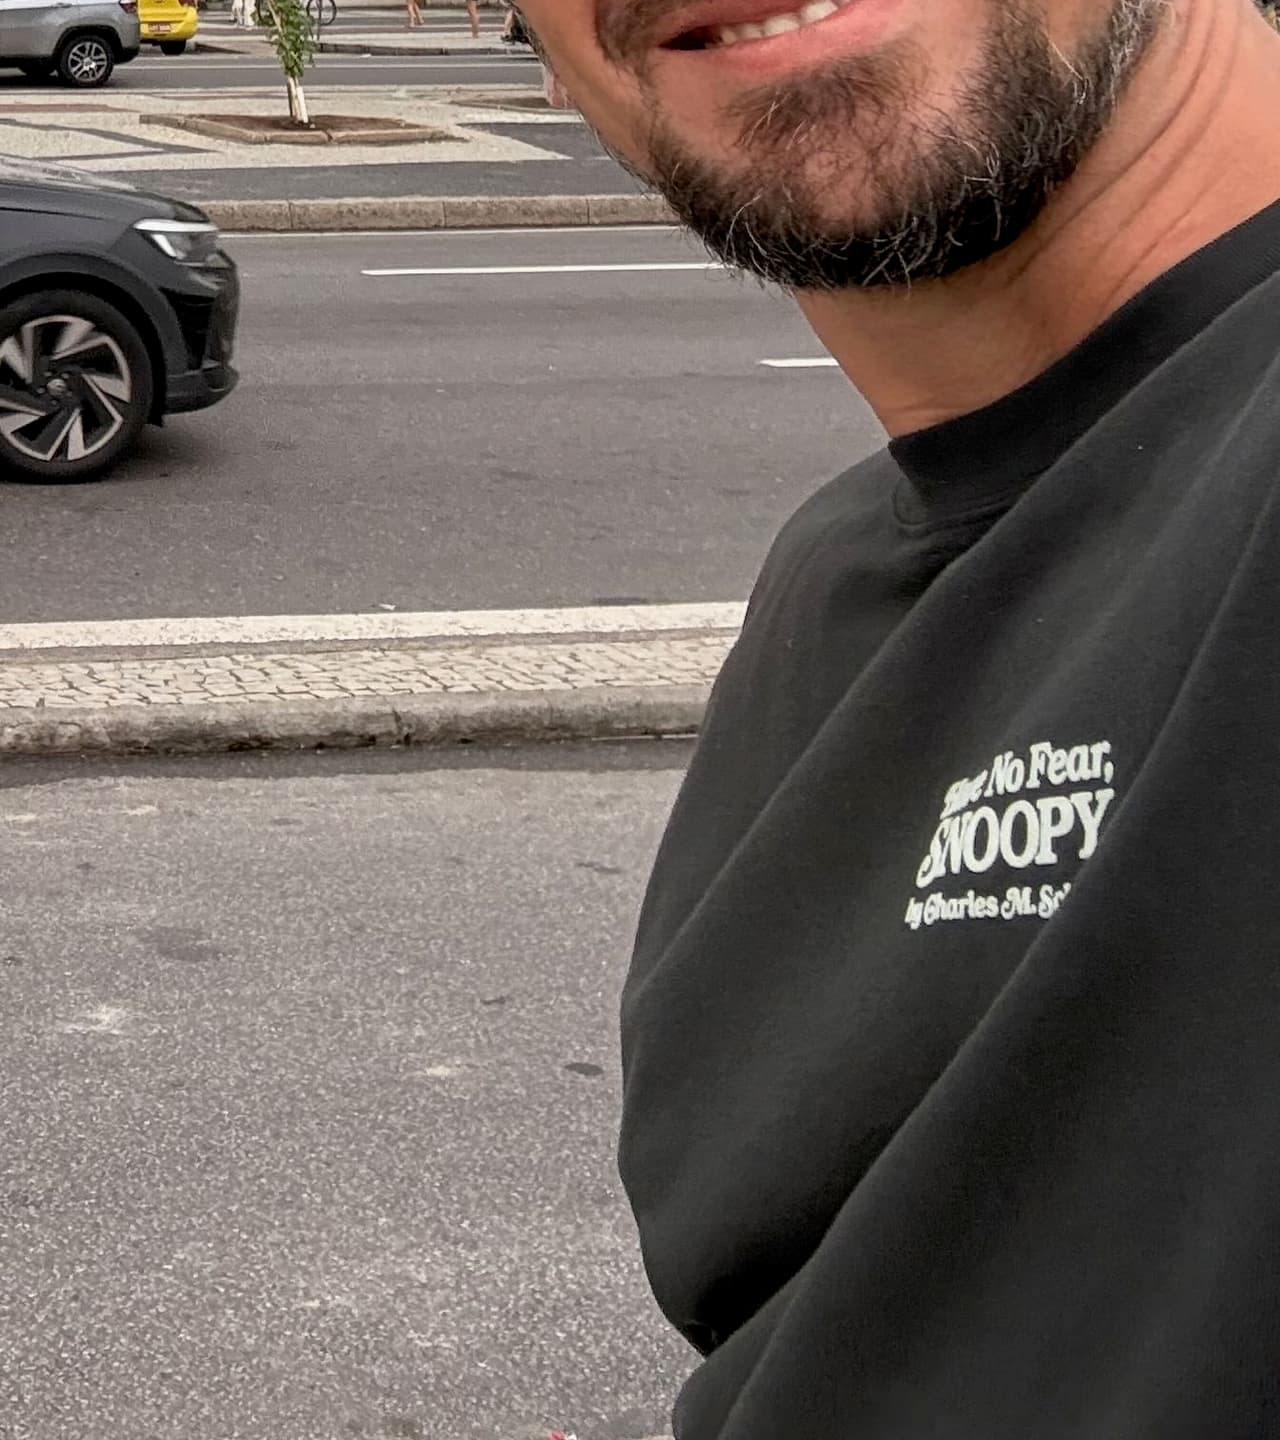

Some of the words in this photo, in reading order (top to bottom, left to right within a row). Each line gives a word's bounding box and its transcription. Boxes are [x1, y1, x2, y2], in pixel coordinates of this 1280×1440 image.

[983, 751, 1025, 797] No
[1026, 740, 1114, 788] Fear,
[916, 788, 1115, 888] SNOOPY
[924, 889, 999, 925] Charles
